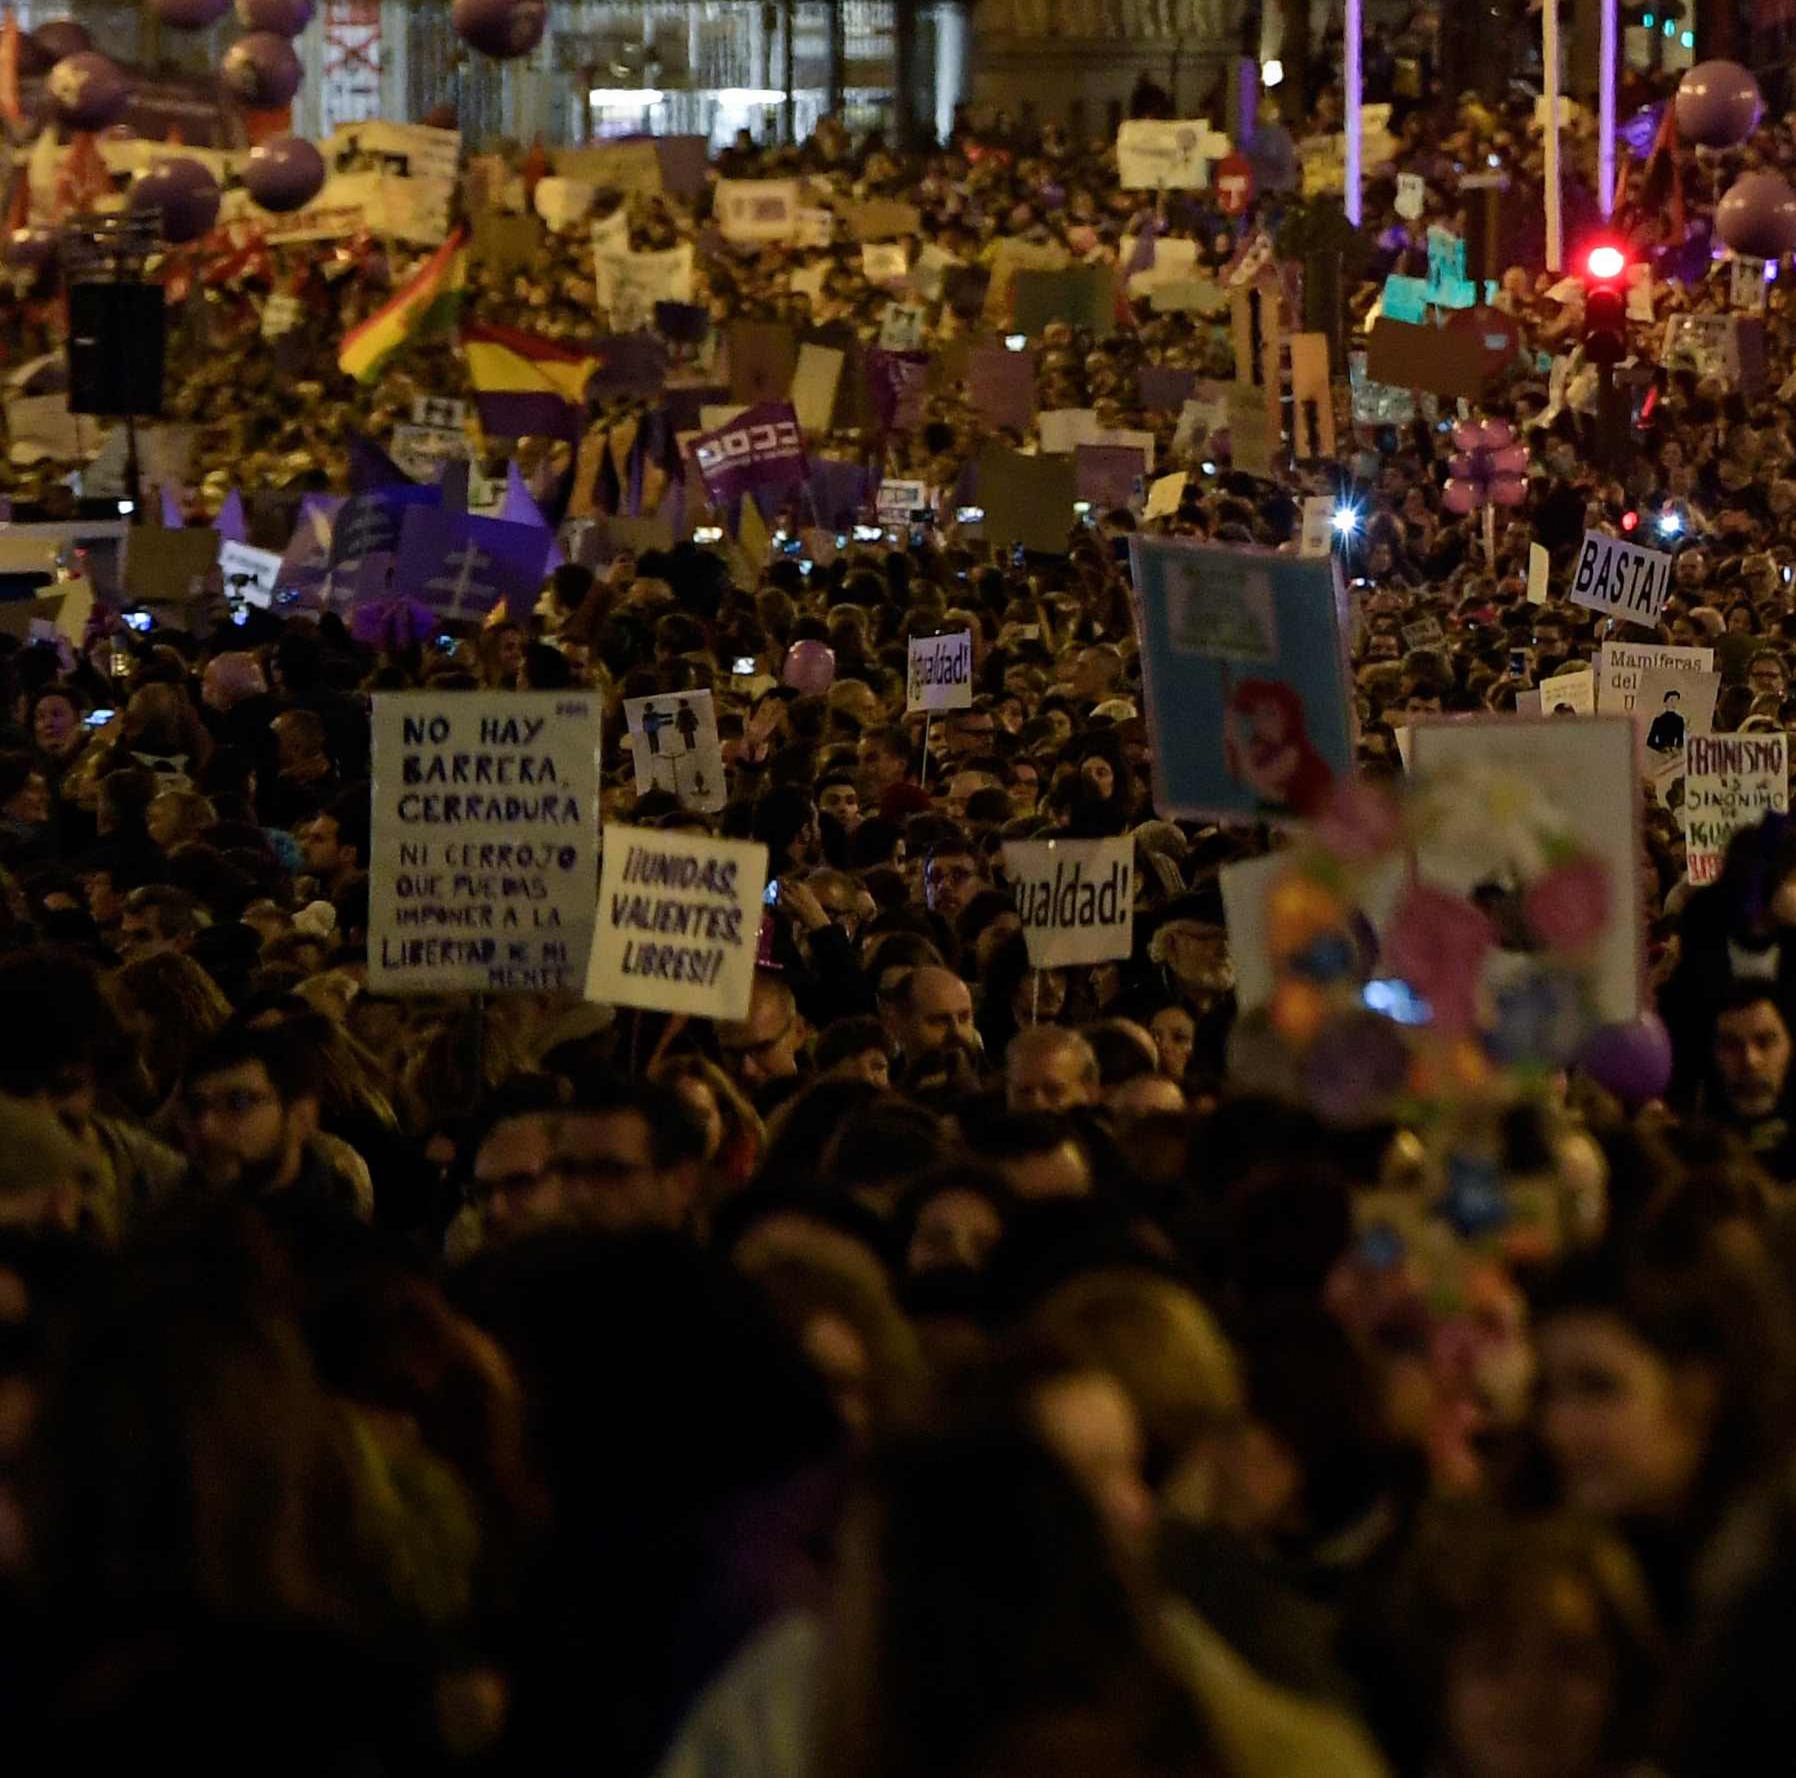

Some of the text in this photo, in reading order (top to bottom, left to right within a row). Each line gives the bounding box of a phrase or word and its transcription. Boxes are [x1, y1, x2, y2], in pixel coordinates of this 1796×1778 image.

[1576, 539, 1667, 616] BASTA!
[1611, 672, 1637, 690] del
[403, 715, 544, 745] NO HAY
[398, 795, 581, 824] CERRADURA
[400, 844, 577, 871] NI CERROJO
[397, 874, 548, 899] QUE PUEDAS
[1015, 862, 1128, 928] ualdad!
[397, 904, 560, 927] IMPONER A LA
[382, 937, 496, 968] LIBERTAD
